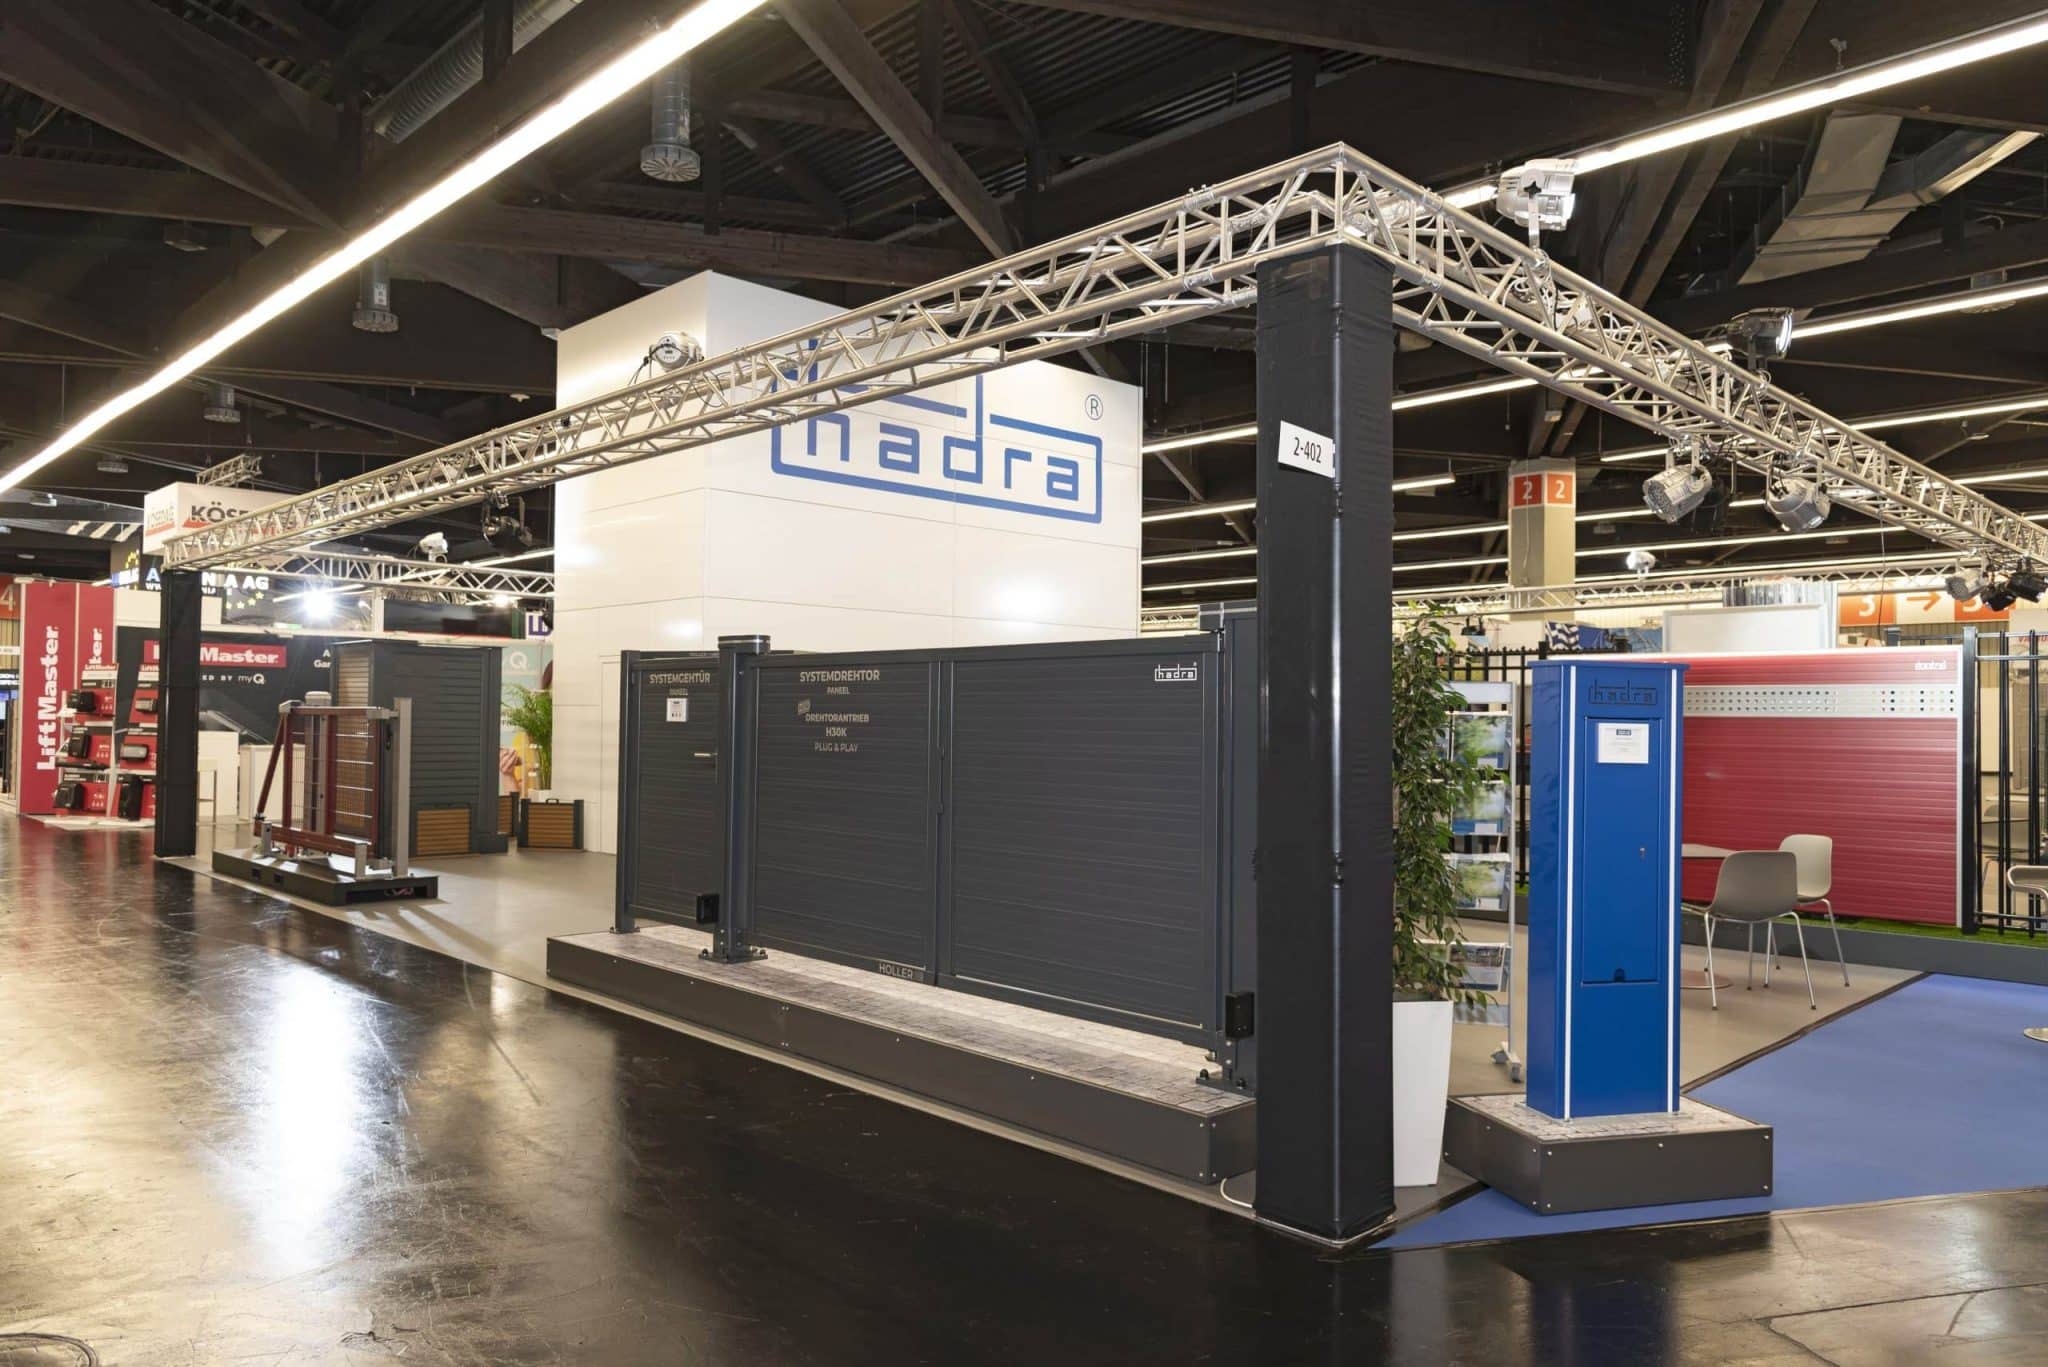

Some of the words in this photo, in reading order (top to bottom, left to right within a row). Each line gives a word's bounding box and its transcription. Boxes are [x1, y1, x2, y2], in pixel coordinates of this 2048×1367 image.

[804, 339, 1080, 502] hadra
[1293, 436, 1322, 464] 2-402
[1523, 480, 1534, 500] 2
[1555, 479, 1566, 500] 2
[650, 671, 711, 684] SYSTEMGEHTÜR
[800, 669, 881, 682] SYSTEMDREHTOR
[1156, 663, 1196, 680] hadra
[238, 673, 266, 685] myQ
[827, 686, 850, 695] PANEEL
[36, 625, 60, 771] LiftMaster
[805, 713, 870, 723] DREHTORANTRIEB
[826, 727, 847, 737] H30K
[814, 742, 833, 752] PLUG
[840, 743, 859, 753] PLAY
